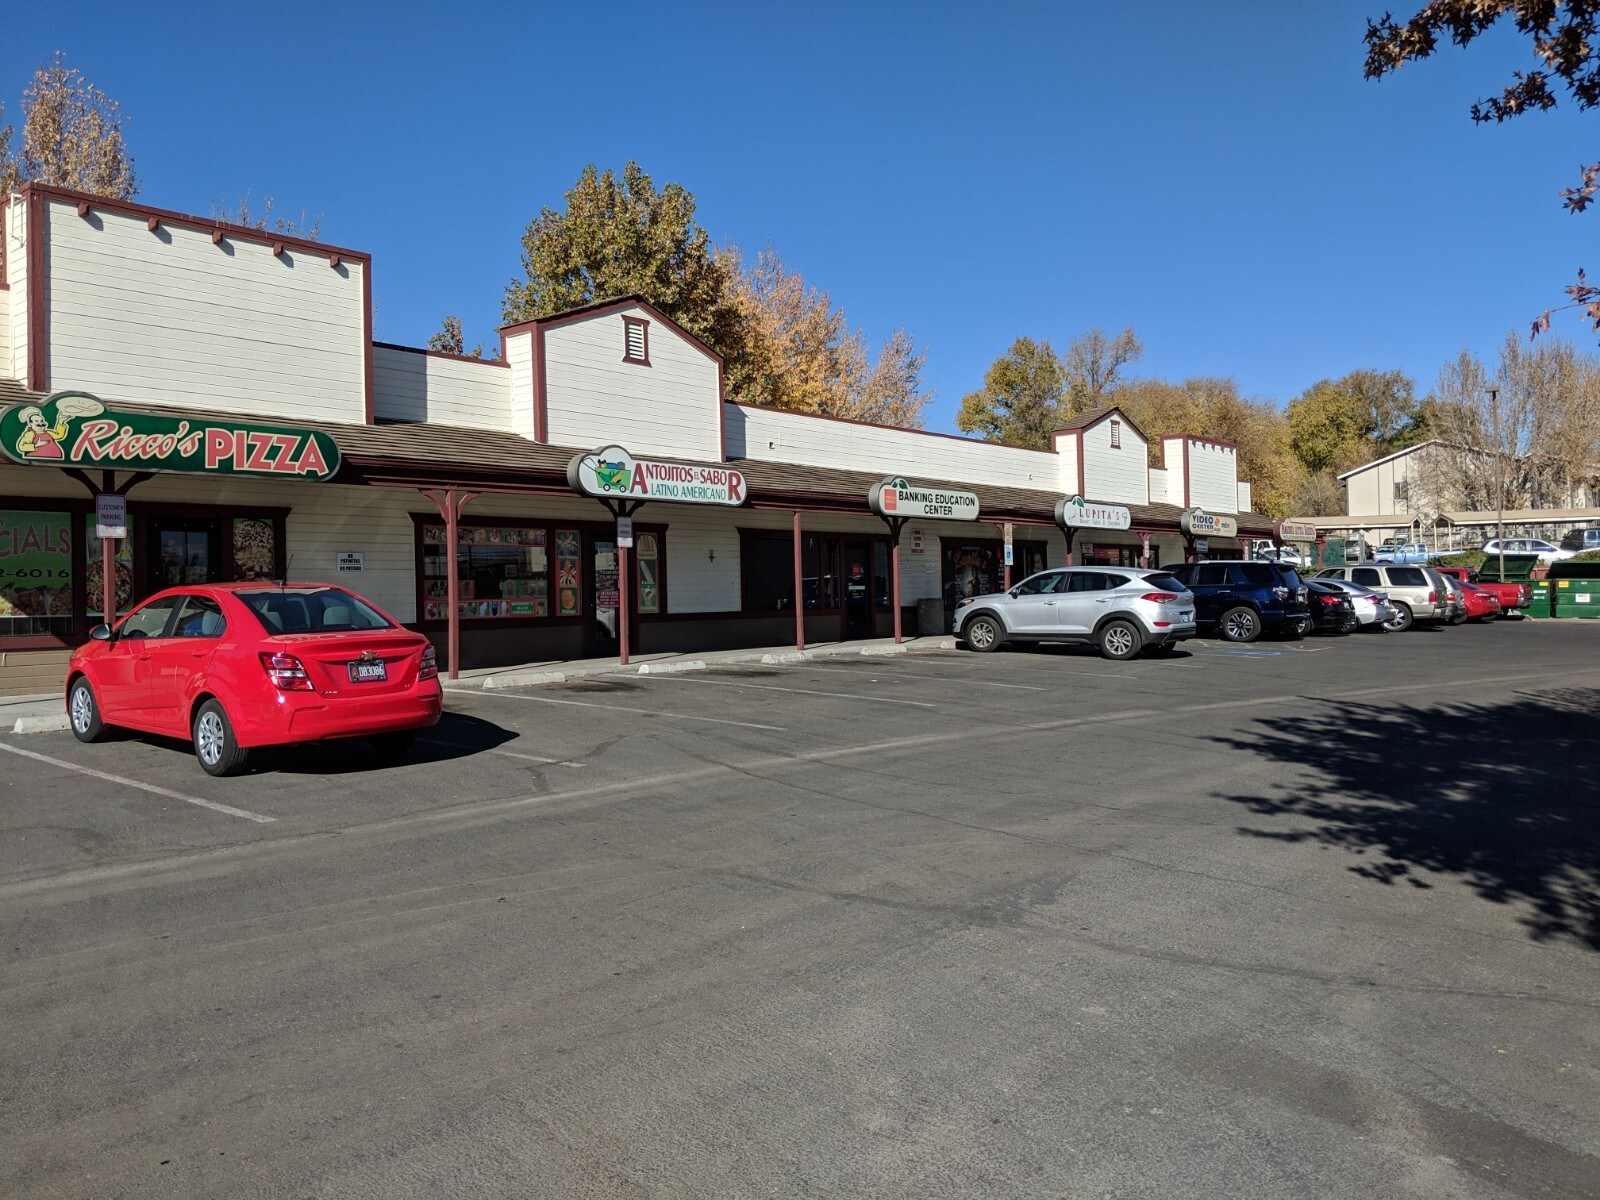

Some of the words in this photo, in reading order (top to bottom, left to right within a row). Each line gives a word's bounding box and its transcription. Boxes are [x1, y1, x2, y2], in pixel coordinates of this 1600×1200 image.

[71, 420, 203, 461] Ricco's
[205, 427, 329, 476] PIZZA
[629, 463, 693, 494] ANTOJITOS
[700, 469, 742, 501] SABOR
[651, 483, 679, 497] LATINO
[681, 485, 726, 501] AMERICANO
[899, 490, 933, 505] BANKING
[935, 493, 975, 507] EDUCATION
[924, 504, 953, 516] CENTER
[1079, 508, 1120, 521] LUPITA'S
[1192, 514, 1214, 525] VIDEO
[1192, 523, 1214, 531] CENTER
